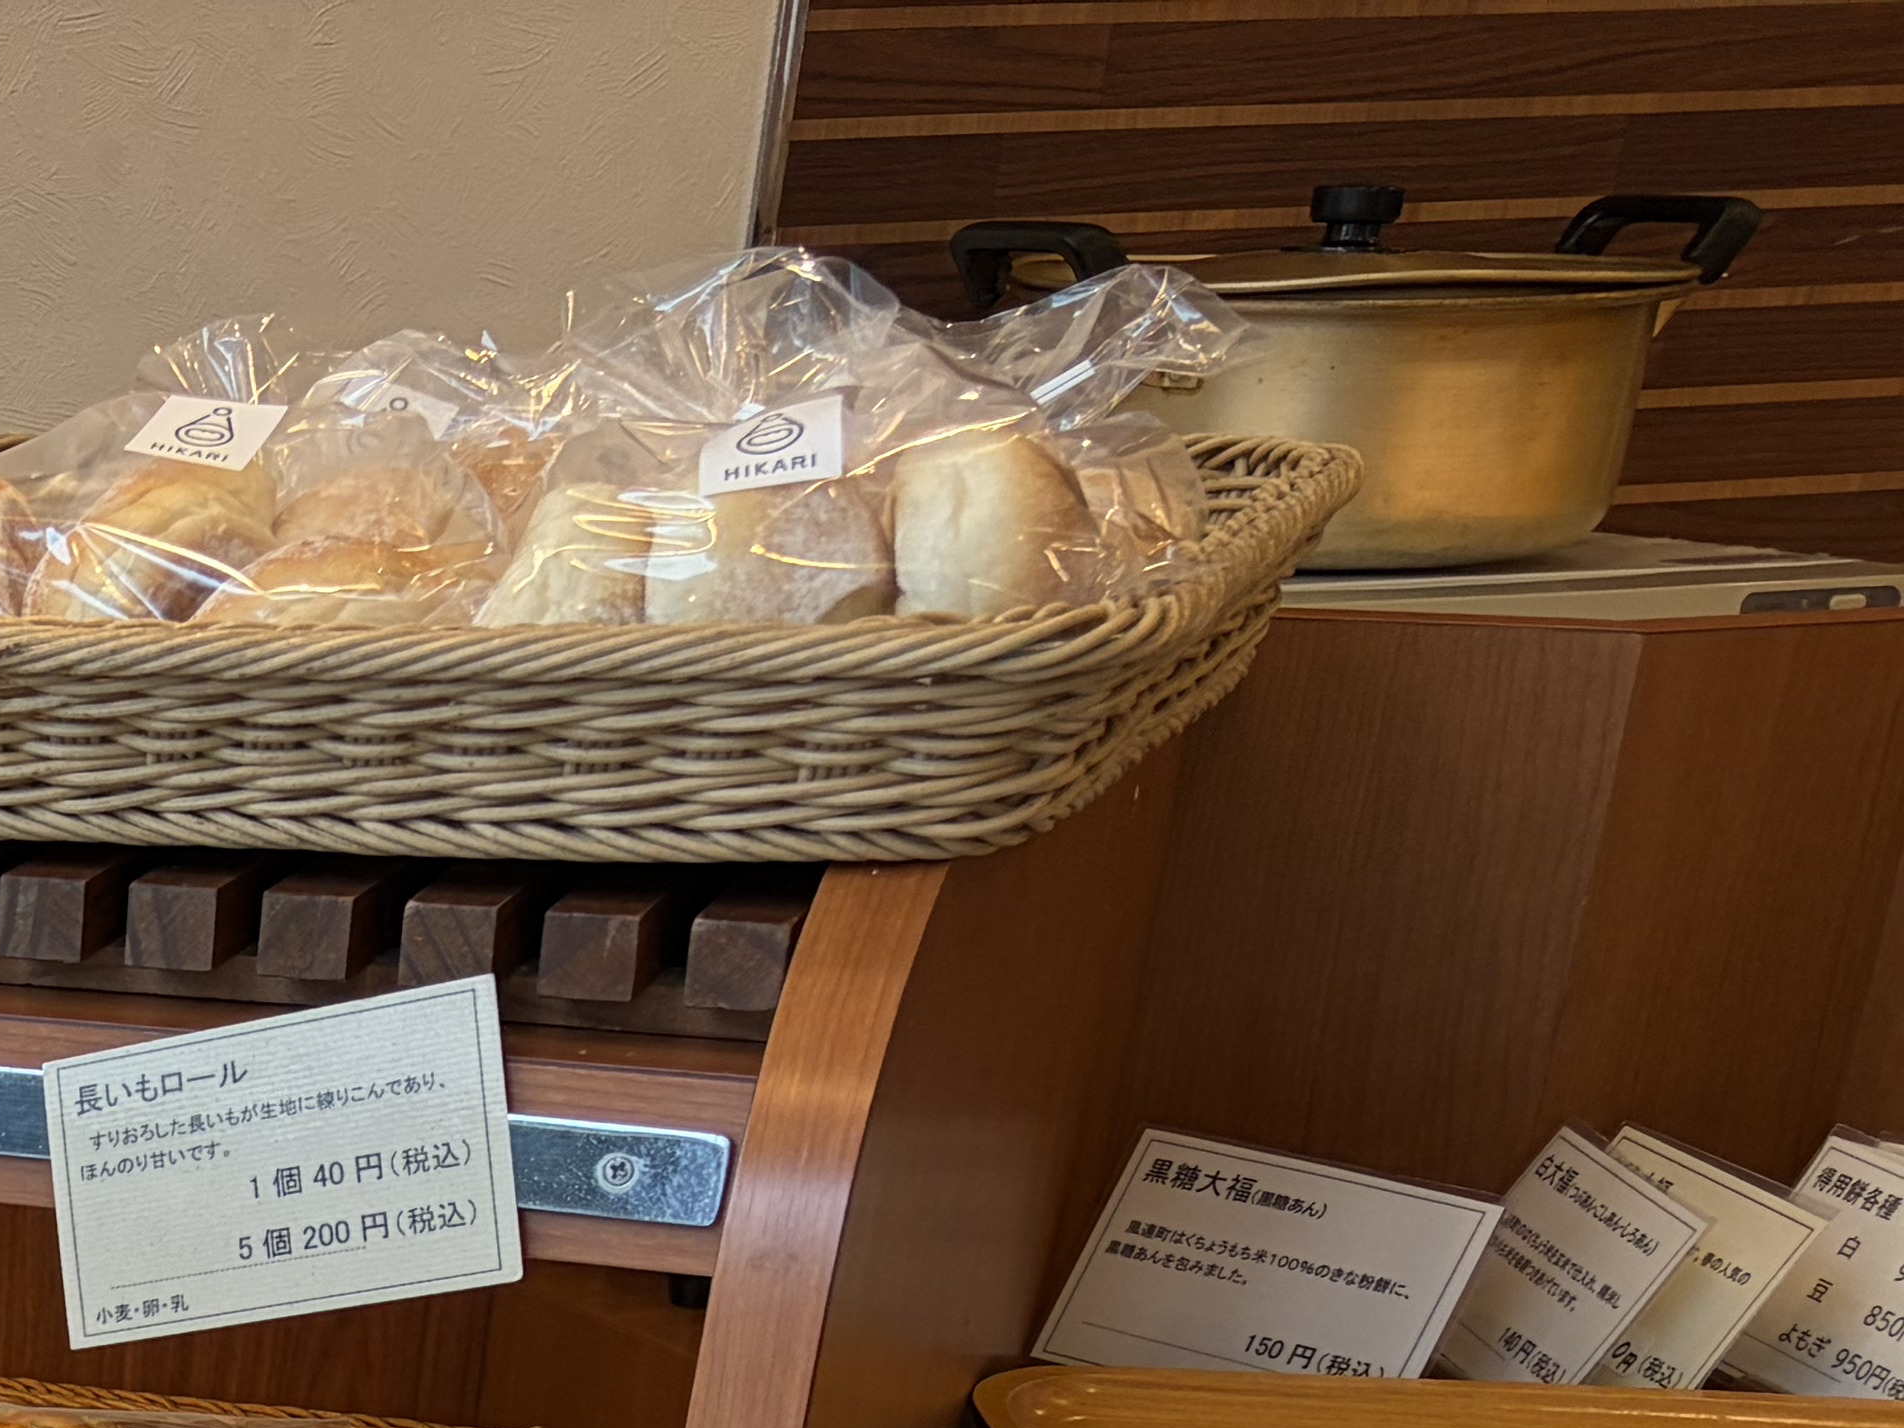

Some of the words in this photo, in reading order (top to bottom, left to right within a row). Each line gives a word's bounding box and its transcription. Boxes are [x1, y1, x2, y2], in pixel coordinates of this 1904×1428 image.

[150, 442, 230, 463] HIKARI
[724, 453, 818, 481] HIKARI
[74, 1060, 248, 1117] 長いもロール
[89, 1073, 447, 1151] すりおろした長いもが生地に練りこんであり、
[80, 1141, 232, 1182] ほんのり甘いです。
[1837, 1235, 1862, 1260] 白
[1806, 1277, 1834, 1303] 豆
[95, 1293, 189, 1326] 小麦・卵・乳
[1863, 1304, 1904, 1342] 850
[1778, 1322, 1832, 1359] よもぎ
